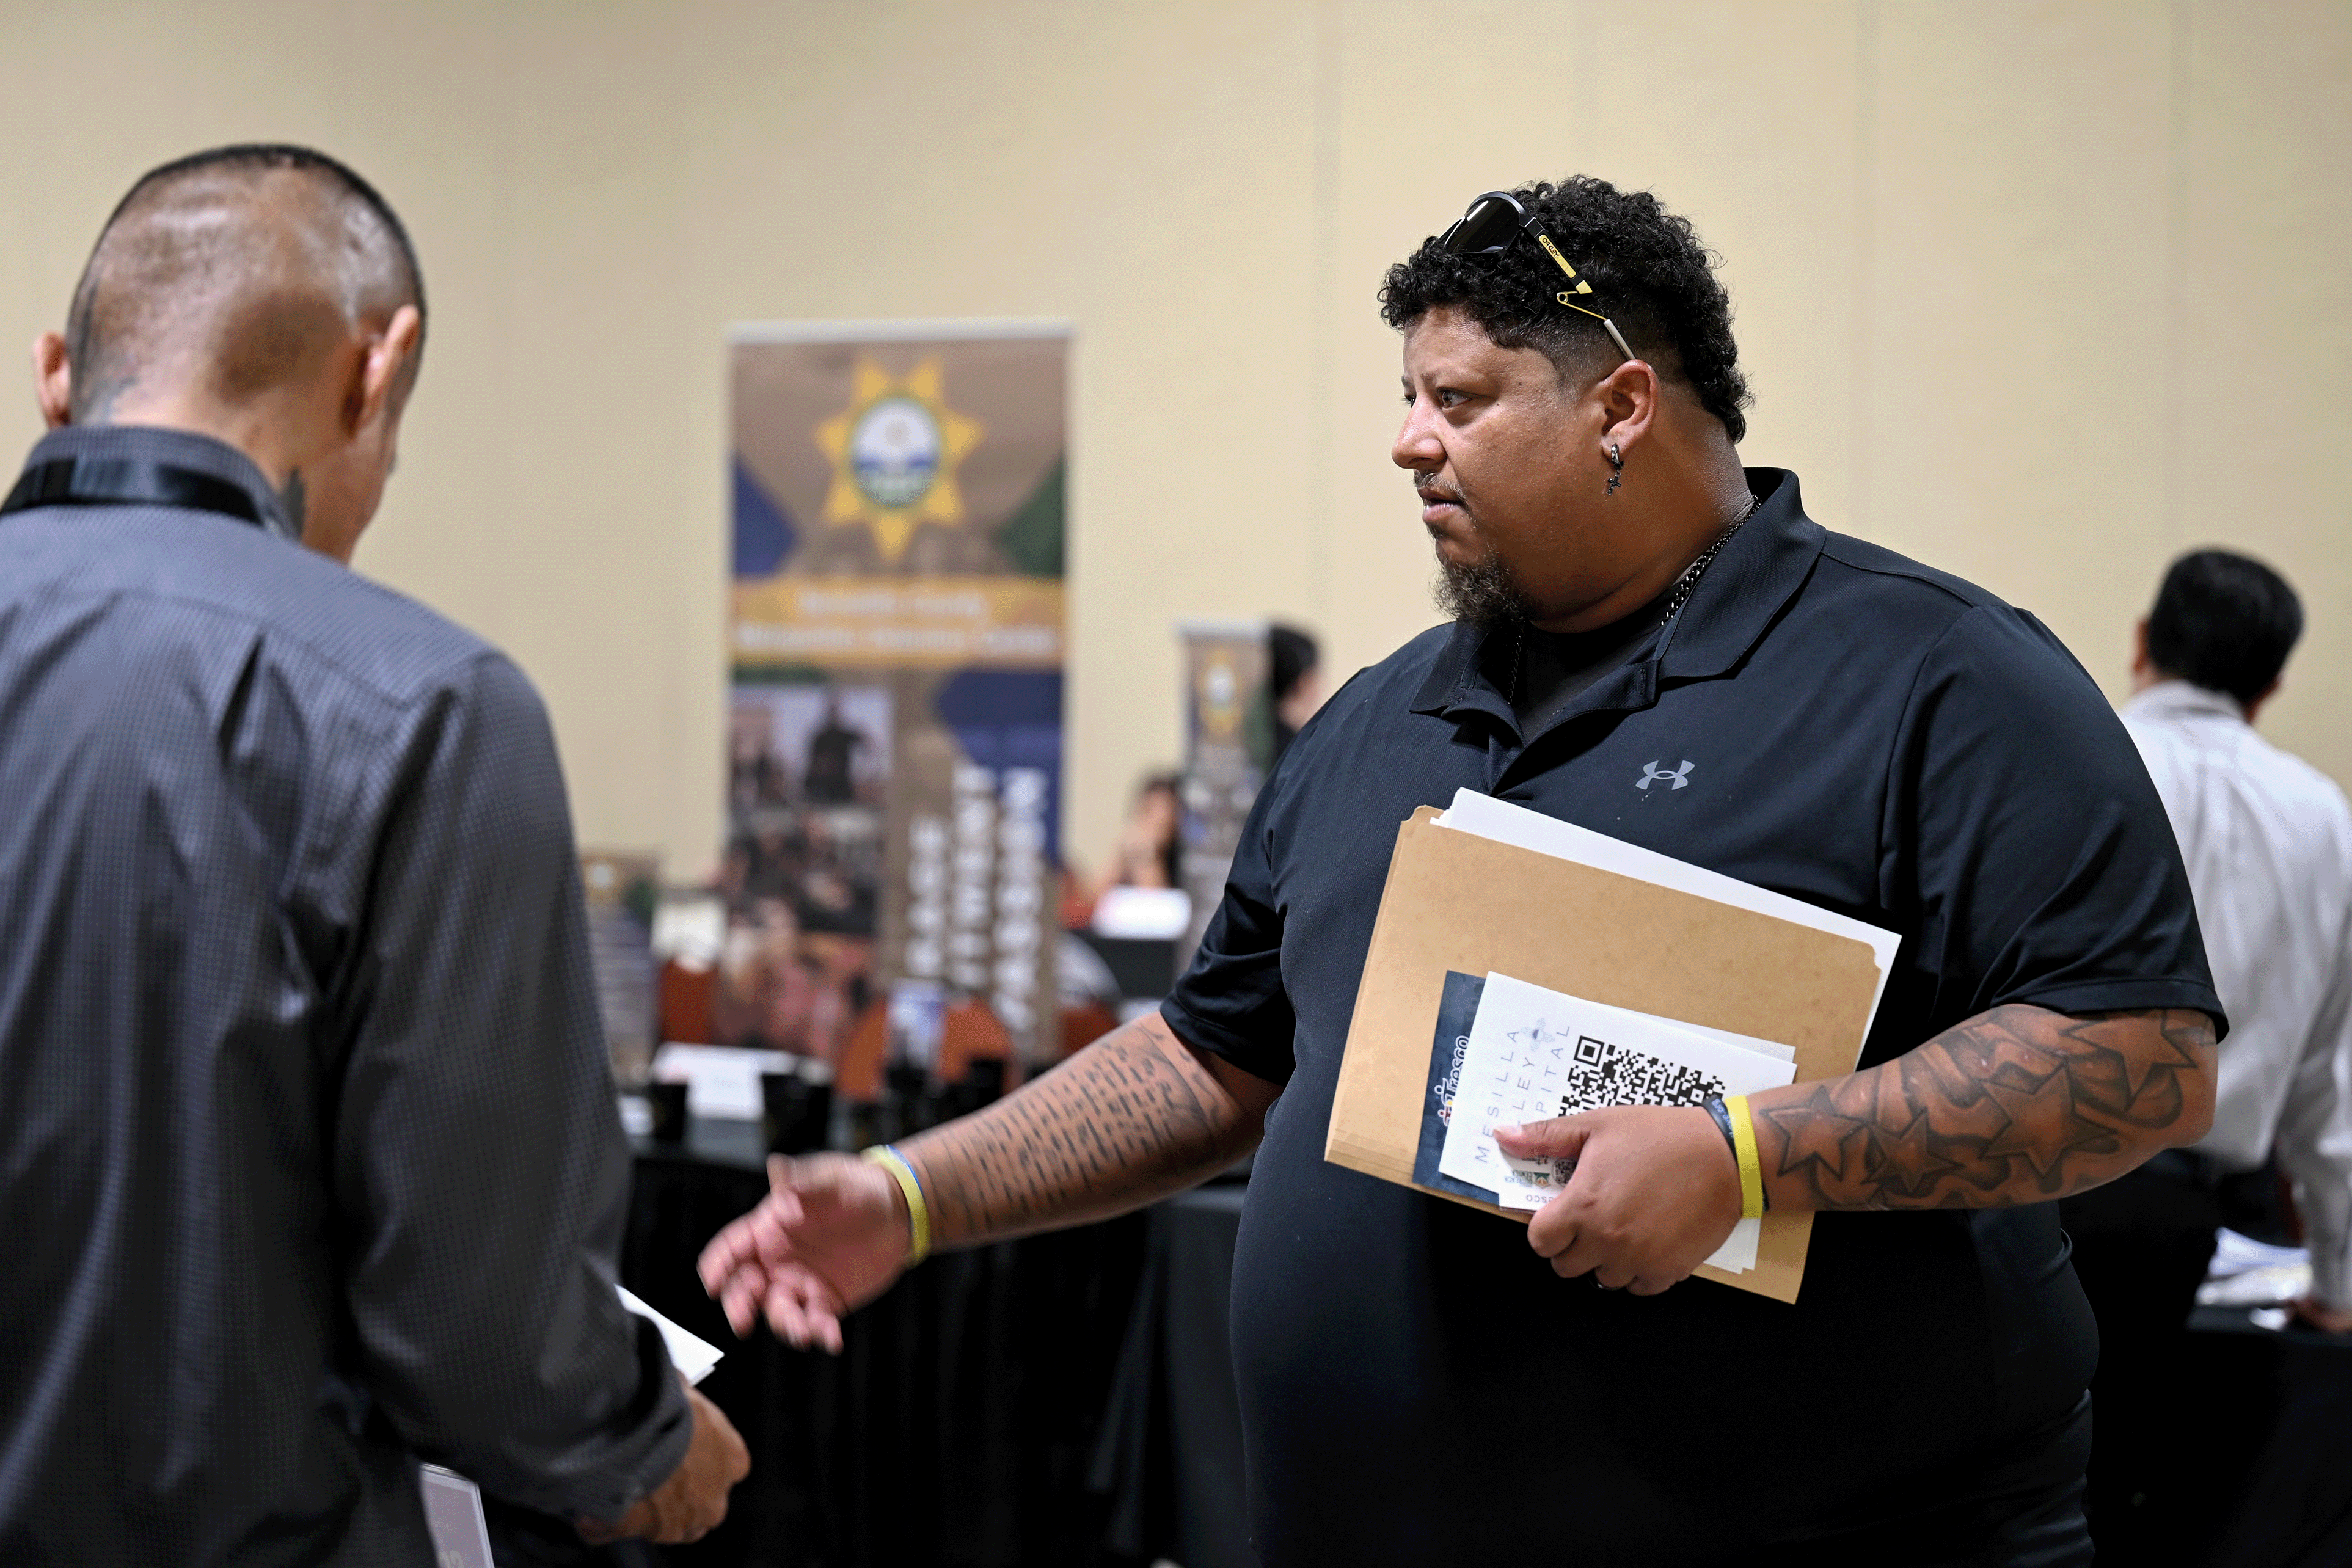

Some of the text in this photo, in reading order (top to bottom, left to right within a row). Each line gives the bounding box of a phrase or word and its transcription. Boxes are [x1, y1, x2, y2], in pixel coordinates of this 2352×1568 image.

[1542, 238, 1560, 257] OAKLEY
[1475, 1031, 1519, 1163] MESILLA
[1535, 1026, 1570, 1114] PITAL
